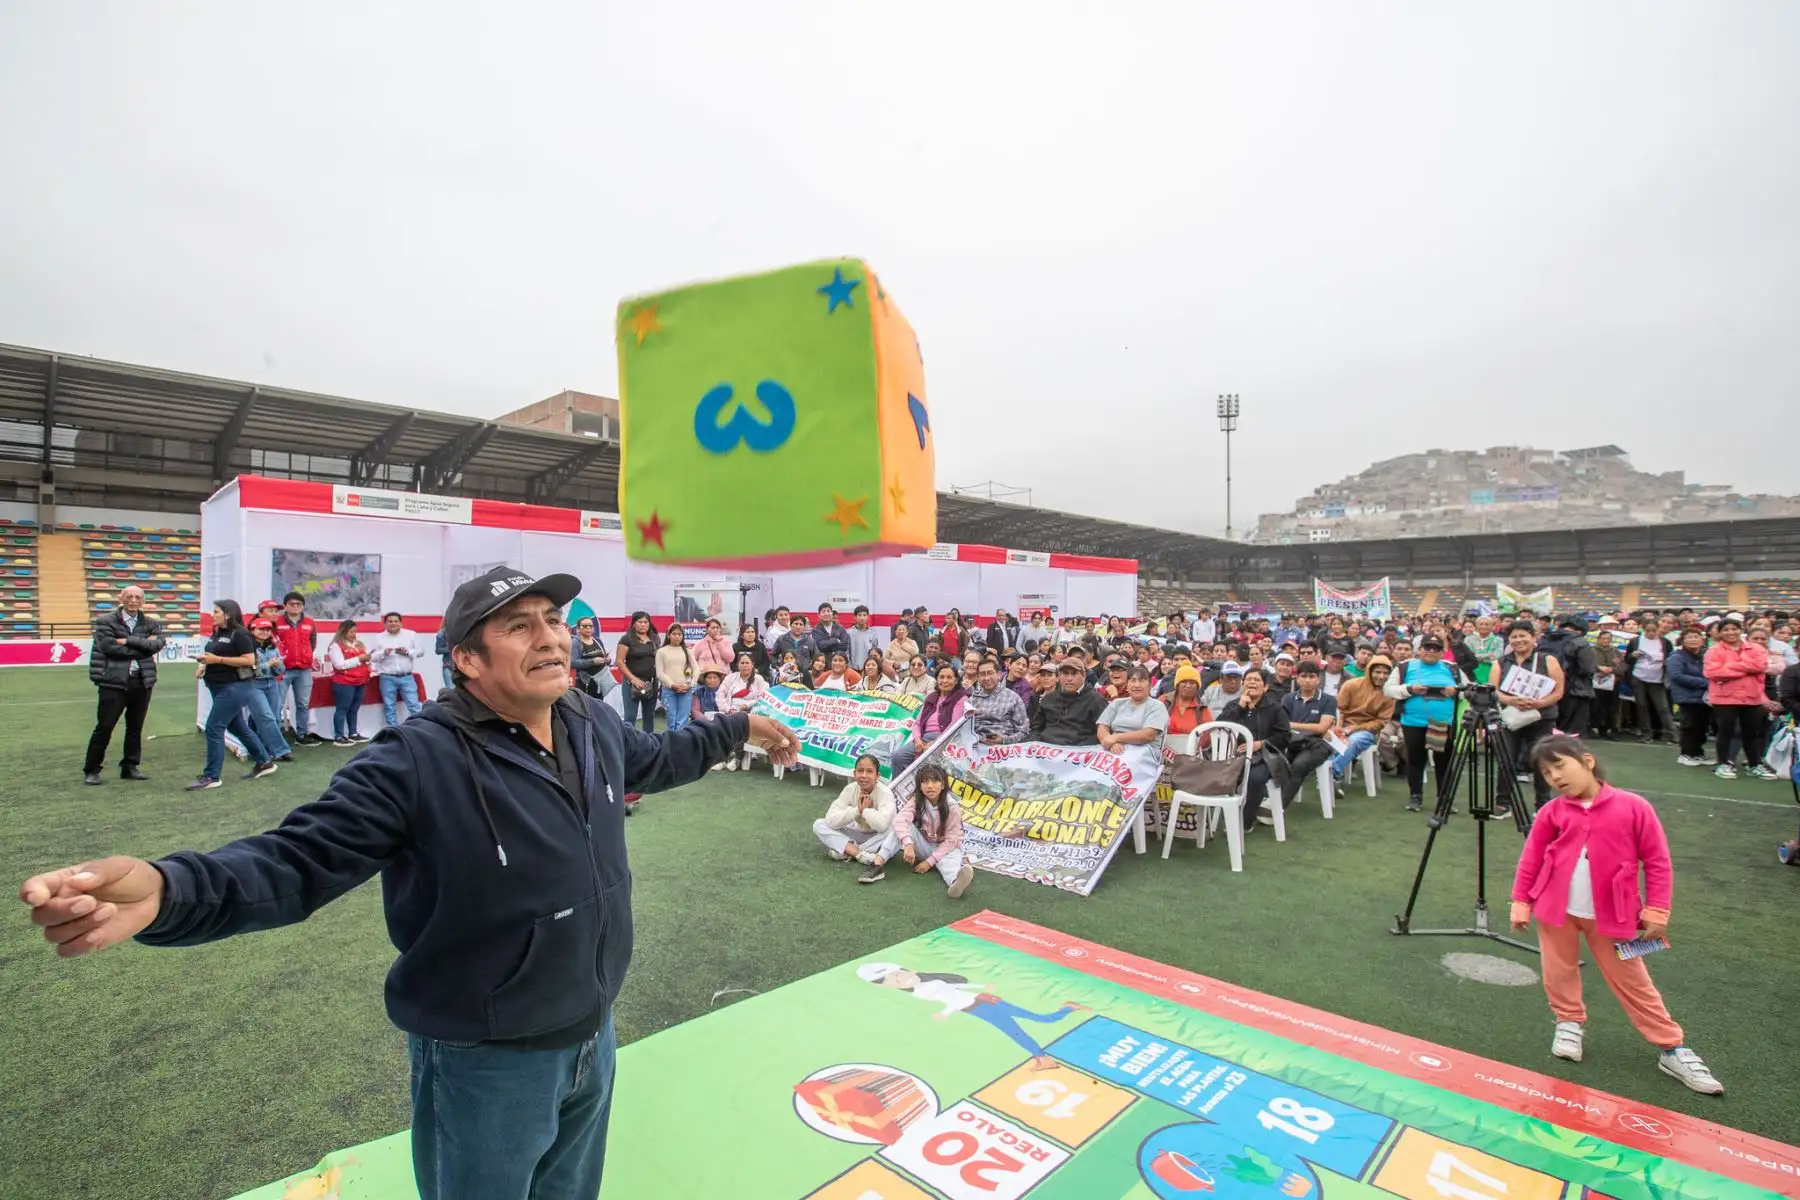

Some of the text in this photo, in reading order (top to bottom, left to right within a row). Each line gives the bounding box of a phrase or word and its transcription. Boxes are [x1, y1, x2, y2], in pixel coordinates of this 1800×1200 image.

[694, 379, 796, 457] 3
[1320, 597, 1385, 610] PRESENTE
[859, 718, 883, 729] MARZO
[948, 775, 1127, 829] EVO HORIZONTE
[1027, 818, 1086, 845] ZONA
[1119, 1041, 1169, 1076] BIEN!
[1177, 1070, 1203, 1089] PARA
[1014, 1078, 1091, 1119] 19
[1472, 1071, 1602, 1116] viviendaperu
[956, 1110, 1052, 1163] REGALO
[1256, 1097, 1336, 1144] 18
[922, 1130, 1027, 1192] 20
